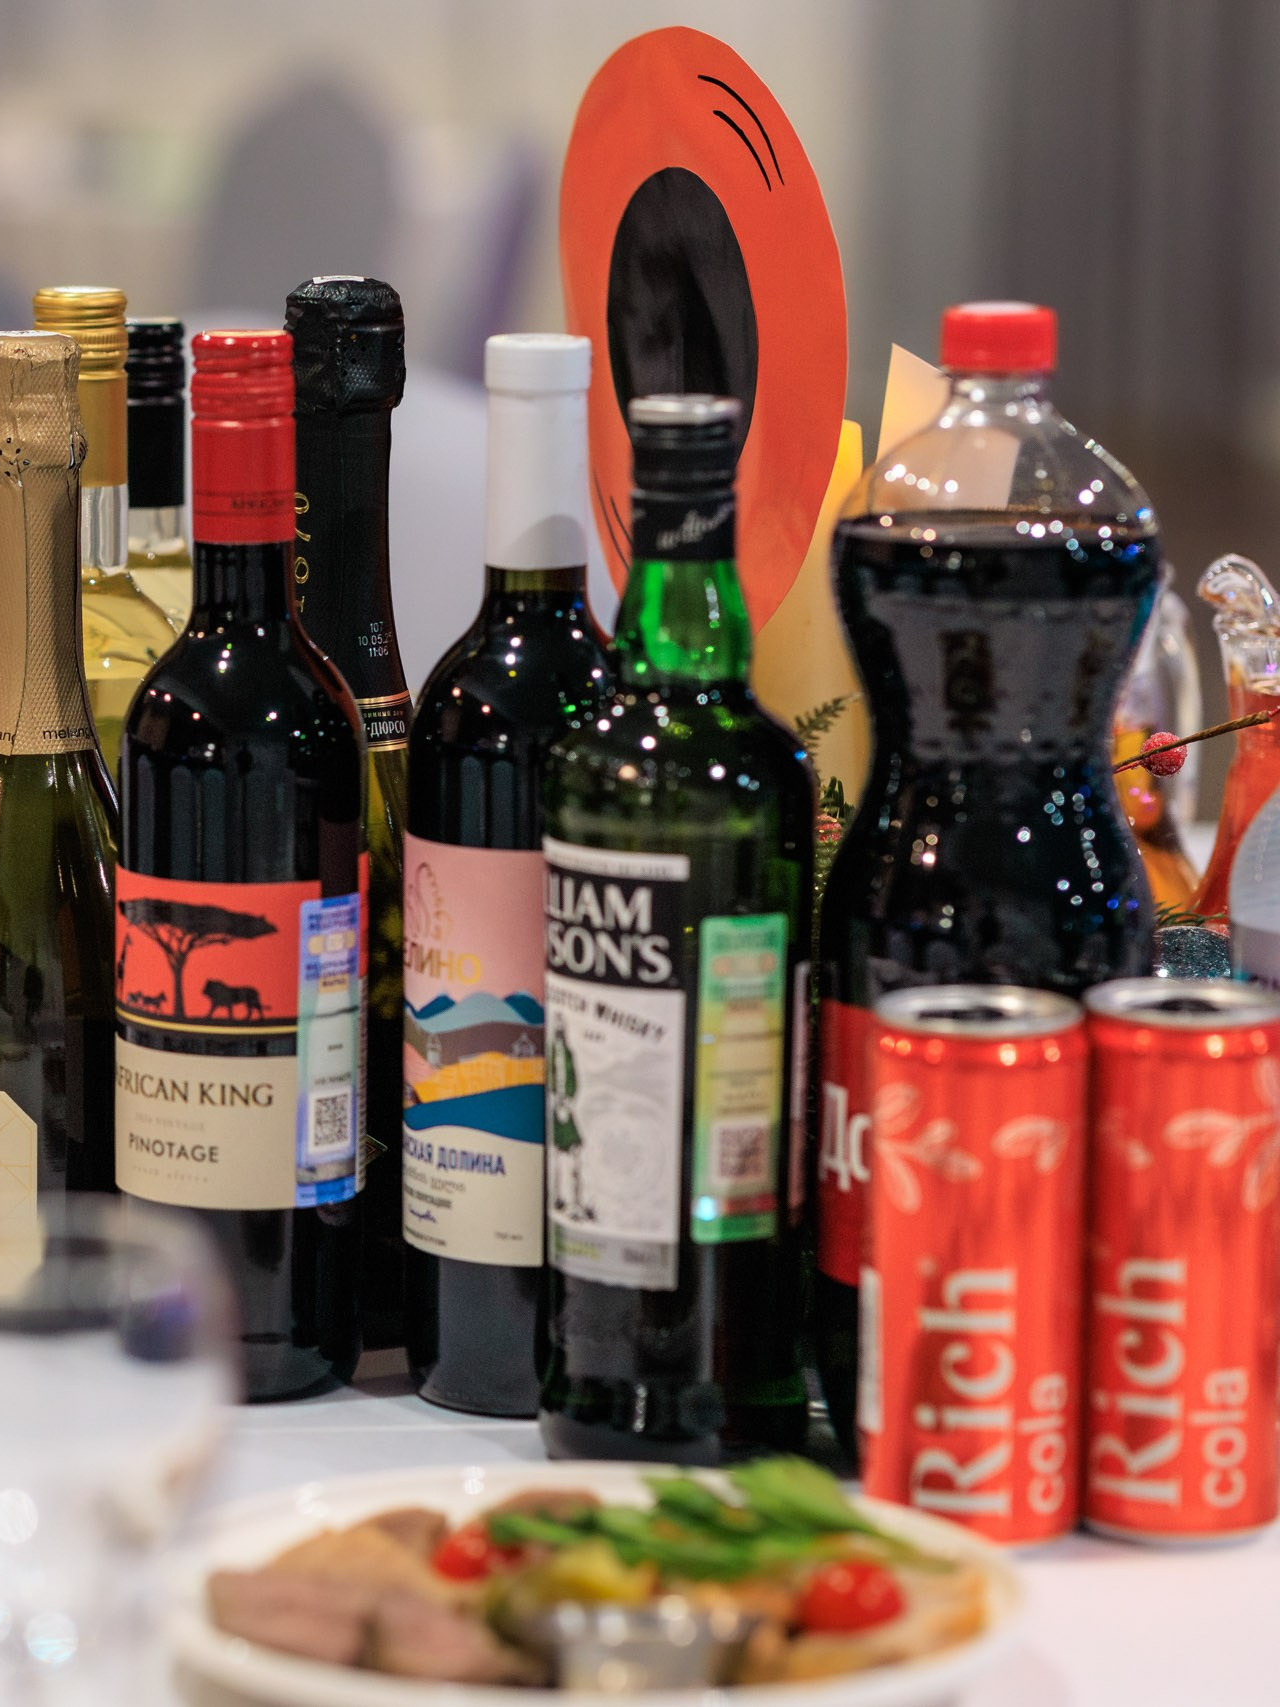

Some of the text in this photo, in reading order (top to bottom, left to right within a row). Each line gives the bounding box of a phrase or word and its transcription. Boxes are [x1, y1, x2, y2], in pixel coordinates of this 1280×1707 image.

[117, 1065, 274, 1108] FRICAN KING
[128, 1132, 220, 1164] PINOTAGE
[437, 1146, 507, 1177] ДОЛИНА
[910, 1267, 1017, 1518] Rich
[1019, 1371, 1069, 1516] cola
[1094, 1257, 1187, 1507] Rich
[1188, 1367, 1250, 1509] cola
